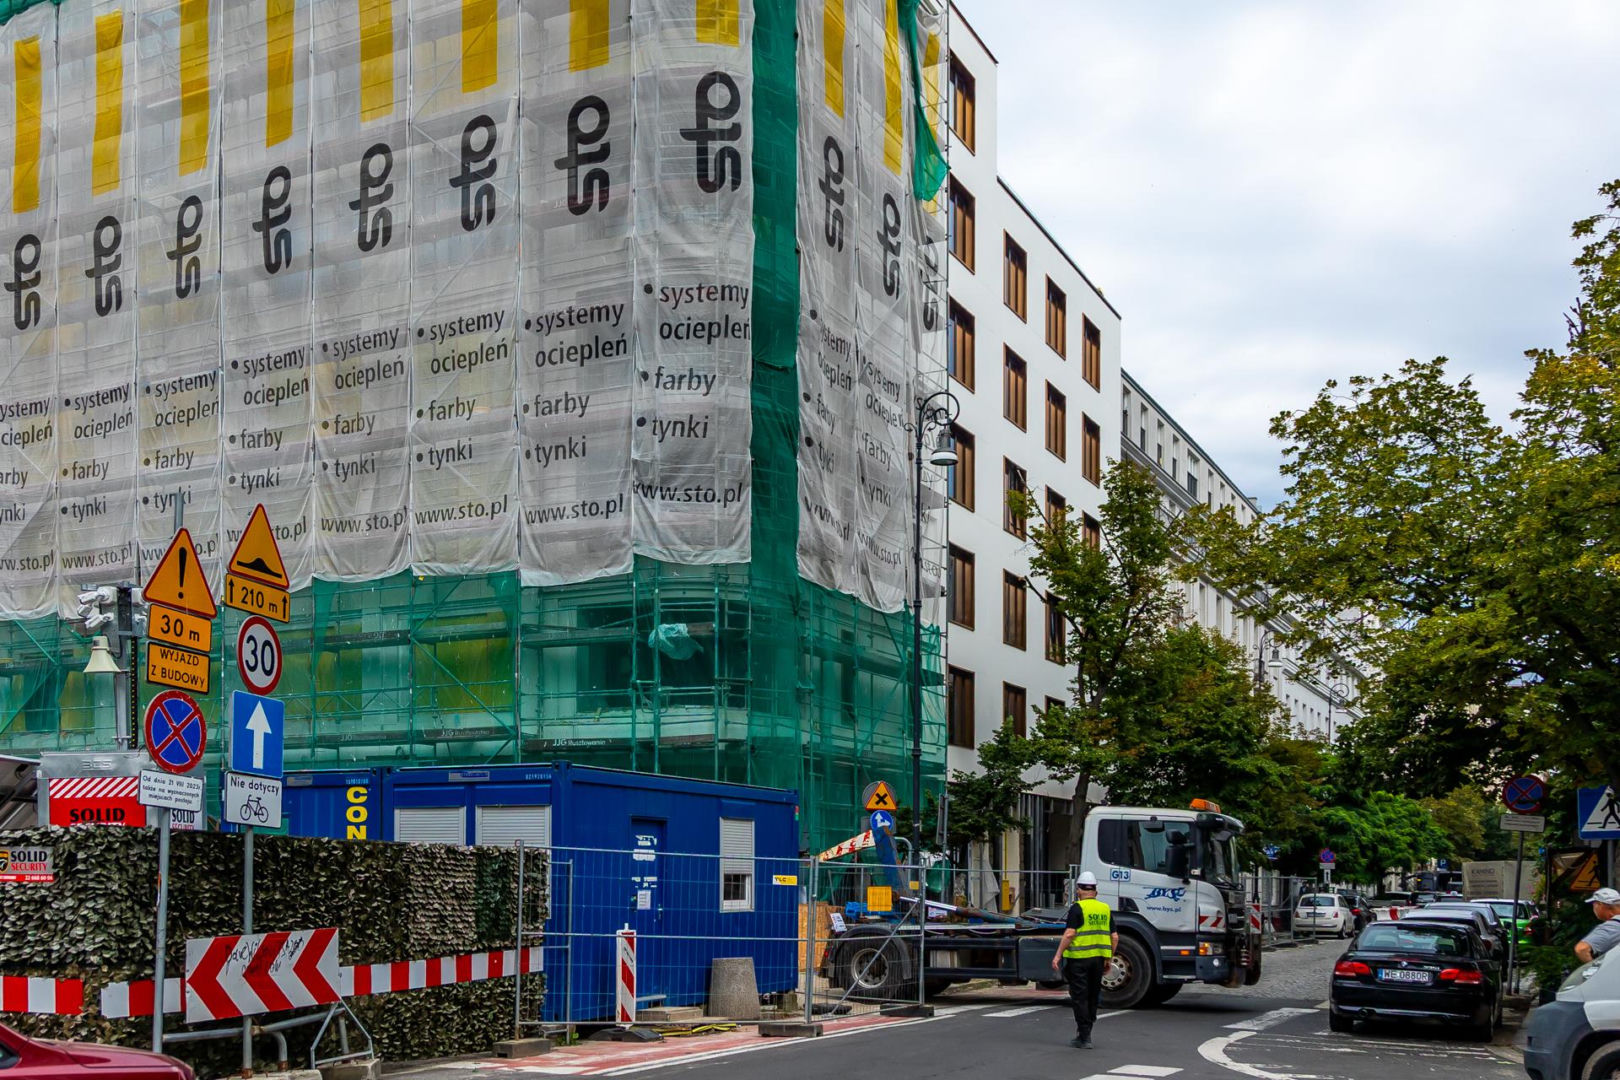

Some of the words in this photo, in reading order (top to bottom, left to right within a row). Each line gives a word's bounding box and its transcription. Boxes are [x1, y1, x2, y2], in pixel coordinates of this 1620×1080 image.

[679, 70, 741, 194] sto
[554, 94, 610, 216] sto
[449, 114, 497, 232] sto
[349, 142, 393, 252] sto
[818, 135, 844, 253] sto
[252, 165, 292, 275] sto
[167, 195, 203, 299] sto
[877, 192, 901, 300] sto
[85, 215, 122, 317] sto
[4, 233, 41, 331] sto
[659, 283, 749, 310] systemy
[430, 309, 505, 344] systemy
[535, 303, 624, 336] systemy
[333, 328, 399, 361] systemy
[431, 337, 508, 374] ociepleń
[535, 333, 627, 367] ociepleń
[243, 346, 305, 378] systemy
[335, 354, 404, 389] ociepleń
[155, 370, 217, 401] systemy
[244, 373, 309, 406] ociepleń
[655, 366, 716, 396] farby
[0, 398, 49, 421] ystemy
[74, 382, 130, 415] systemy
[155, 396, 219, 427] ociepleń
[429, 396, 476, 421] farby
[534, 391, 590, 417] farby
[1, 421, 53, 449] ciepleń
[74, 407, 132, 439] ociepleń
[334, 412, 375, 435] farby
[652, 414, 708, 442] tynki
[241, 428, 283, 451] farby
[428, 438, 472, 470] tynki
[535, 435, 586, 468] tynki
[72, 458, 109, 481] farby
[155, 448, 194, 470] farby
[334, 452, 375, 482] tynki
[0, 467, 28, 488] arby
[241, 467, 280, 494] tynki
[72, 496, 107, 522] tynki
[415, 494, 507, 524] www.sto.pl
[524, 493, 624, 525] www.sto.pl
[868, 483, 891, 507] ynki
[321, 505, 408, 532] www.sto.pl
[62, 541, 132, 569] www.sto.pl
[241, 586, 264, 609] 210
[268, 602, 278, 614] m
[160, 614, 184, 637] 30
[189, 629, 200, 642] m
[160, 648, 199, 667] WYJAZD
[245, 634, 275, 677] 30
[151, 664, 157, 676] Z
[161, 667, 205, 688] BUDOWY
[230, 776, 245, 788] Nie
[248, 780, 280, 796] dotyczy
[69, 807, 125, 823] SOLID
[171, 809, 195, 823] SOLID
[10, 850, 48, 862] SOLID
[10, 862, 48, 871] SECURITY
[1111, 870, 1129, 880] G13
[1383, 969, 1398, 979] WE
